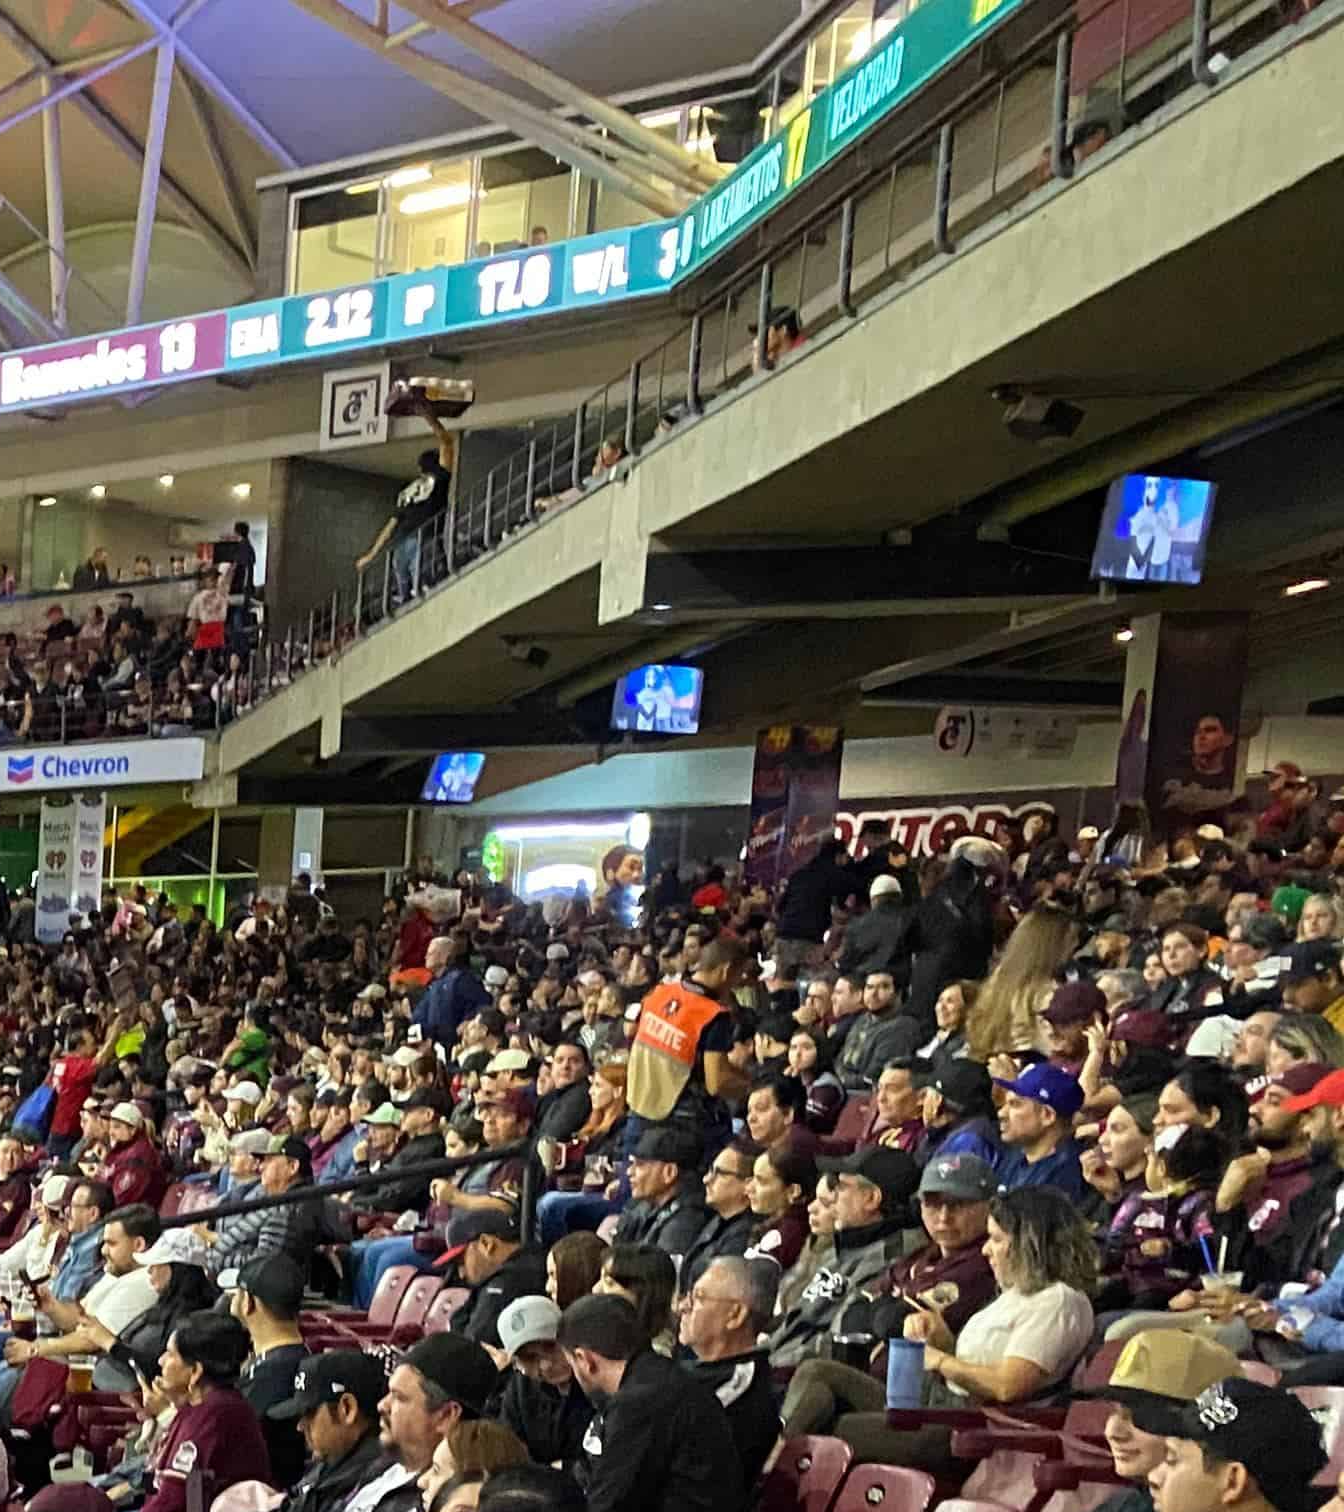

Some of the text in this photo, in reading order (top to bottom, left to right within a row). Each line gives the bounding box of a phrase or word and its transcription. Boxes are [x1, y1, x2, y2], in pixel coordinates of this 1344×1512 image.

[831, 36, 905, 141] VELOCIDAD
[701, 142, 783, 249] LANZAMIENTOS
[42, 755, 130, 778] Chevron
